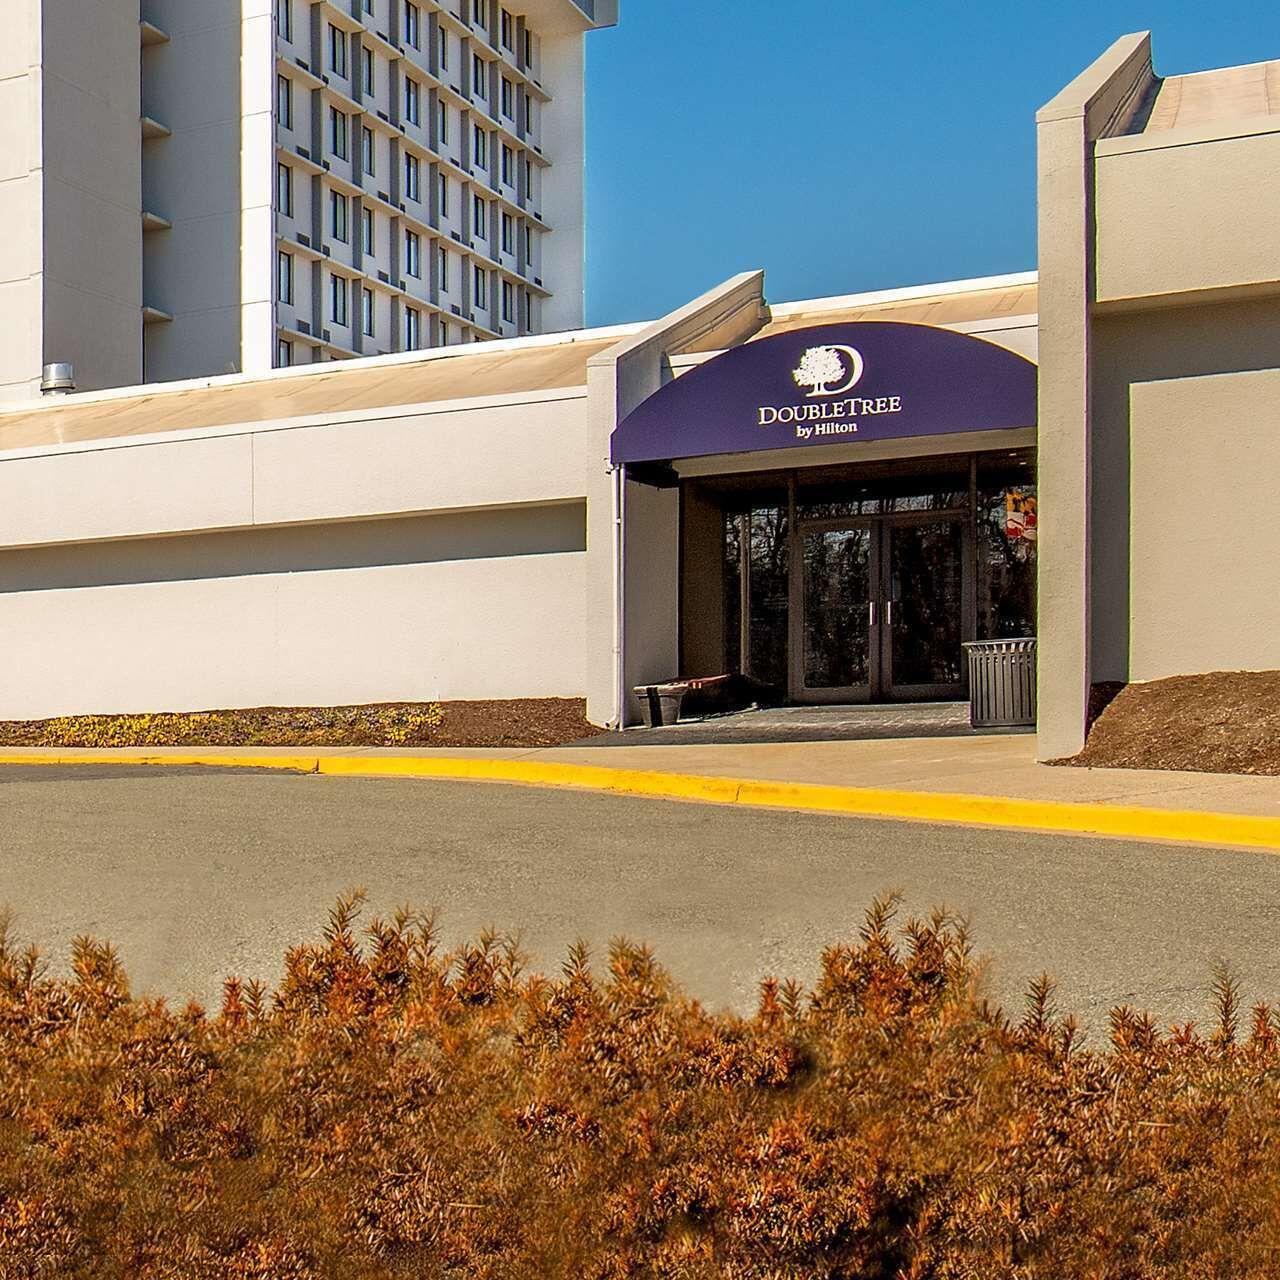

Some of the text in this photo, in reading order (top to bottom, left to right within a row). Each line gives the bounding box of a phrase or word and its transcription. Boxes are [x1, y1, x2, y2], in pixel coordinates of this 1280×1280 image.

[758, 396, 902, 425] DOUBLETREE
[796, 422, 858, 439] by Hilton
